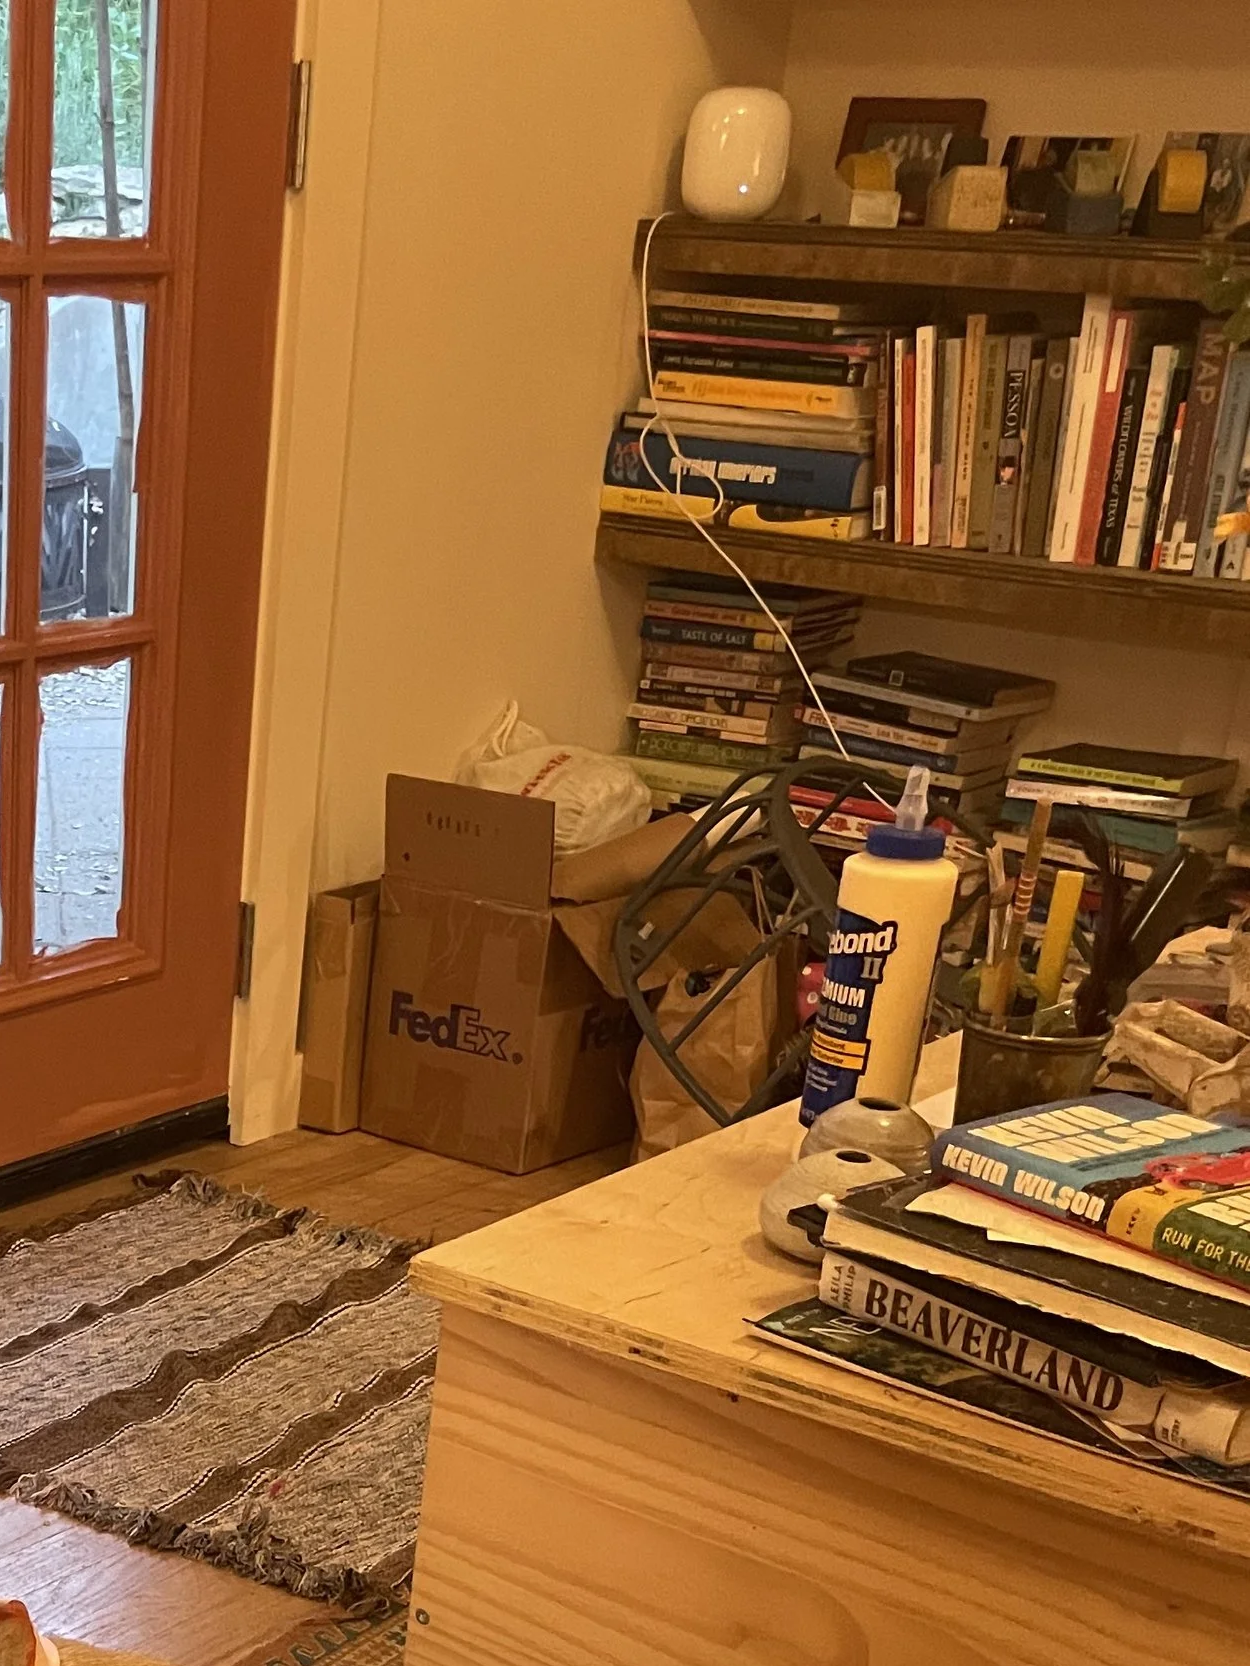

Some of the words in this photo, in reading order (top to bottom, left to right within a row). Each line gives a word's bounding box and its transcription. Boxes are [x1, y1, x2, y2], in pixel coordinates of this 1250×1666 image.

[1197, 331, 1224, 405] MAP
[1003, 371, 1025, 438] PESSOA
[1111, 404, 1134, 484] WILDFLOWERS
[1105, 496, 1119, 528] TEXAS
[682, 628, 705, 641] TASTE
[710, 632, 725, 643] OF
[726, 633, 747, 645] SALT
[860, 956, 883, 980] II
[821, 977, 866, 1009] MIUM
[389, 990, 511, 1062] FedEx
[942, 1144, 1009, 1187] KEVIN
[1014, 1169, 1105, 1222] WILSON
[1162, 1227, 1192, 1250] RUN
[1194, 1239, 1225, 1262] FOR
[830, 1265, 844, 1302] LEILA
[842, 1264, 857, 1310] PHILIP
[865, 1278, 1125, 1411] BEAVERLAND
